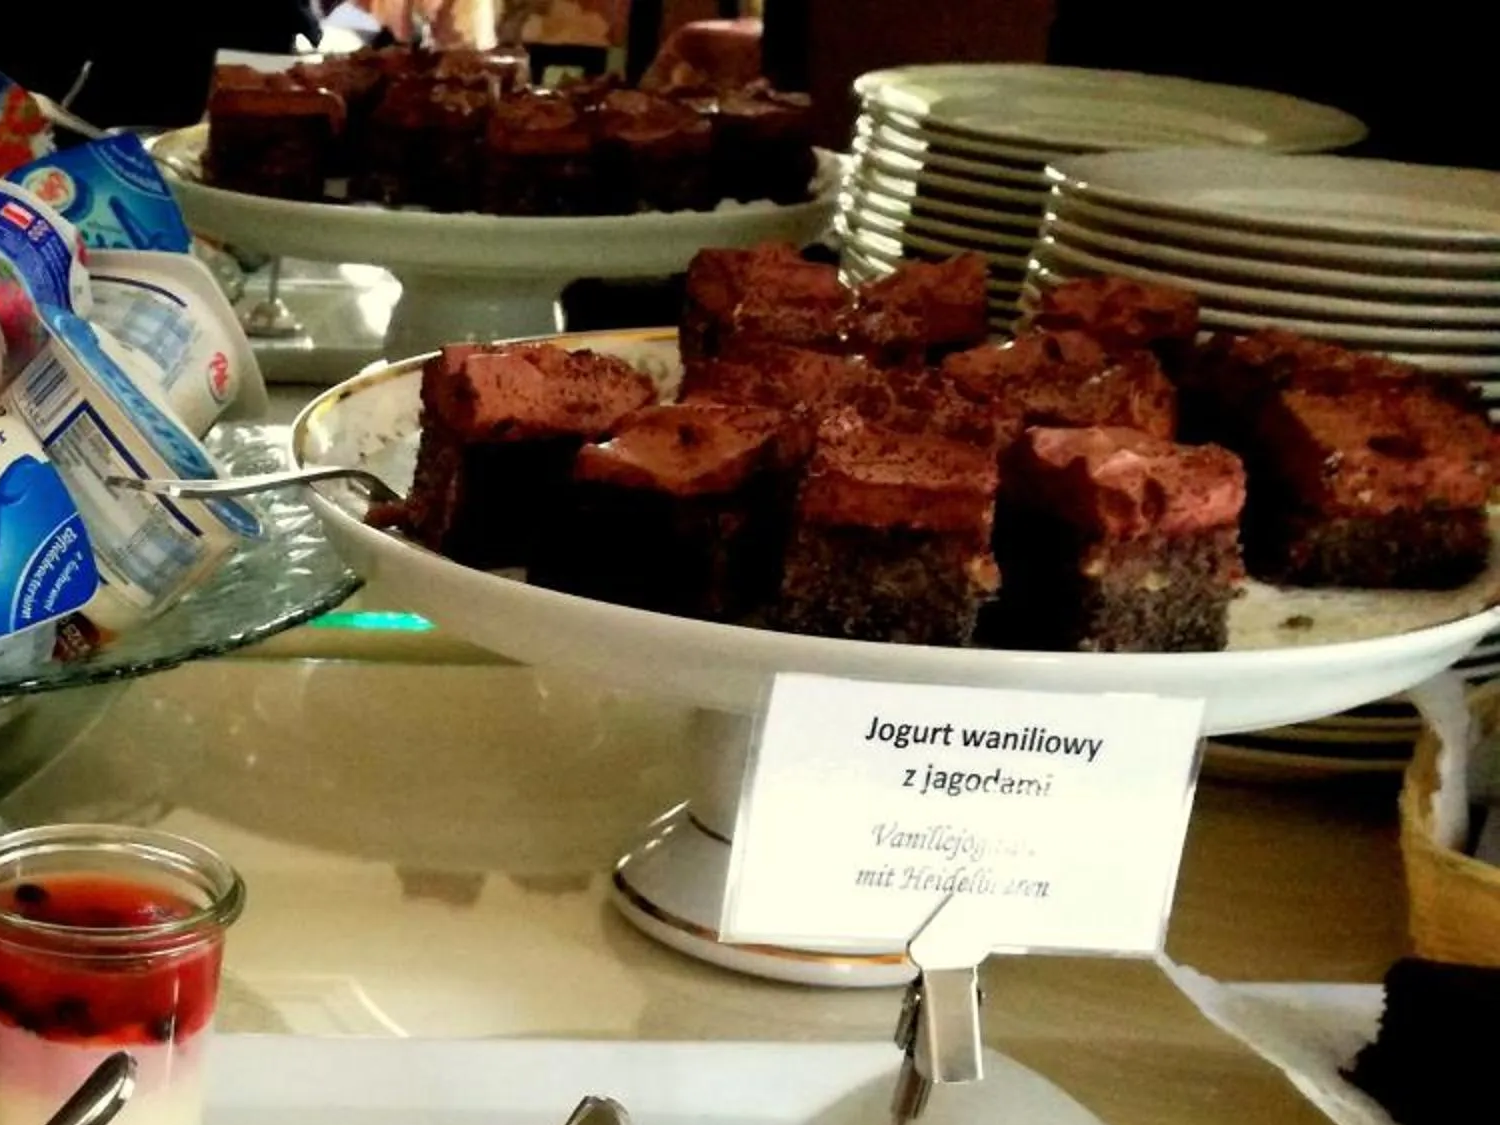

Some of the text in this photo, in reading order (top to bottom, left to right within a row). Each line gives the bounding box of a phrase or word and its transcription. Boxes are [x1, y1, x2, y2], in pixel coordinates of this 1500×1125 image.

[865, 716, 1103, 762] Jogurt waniliowy
[902, 764, 1054, 797] z jagodami
[855, 864, 895, 888] mit
